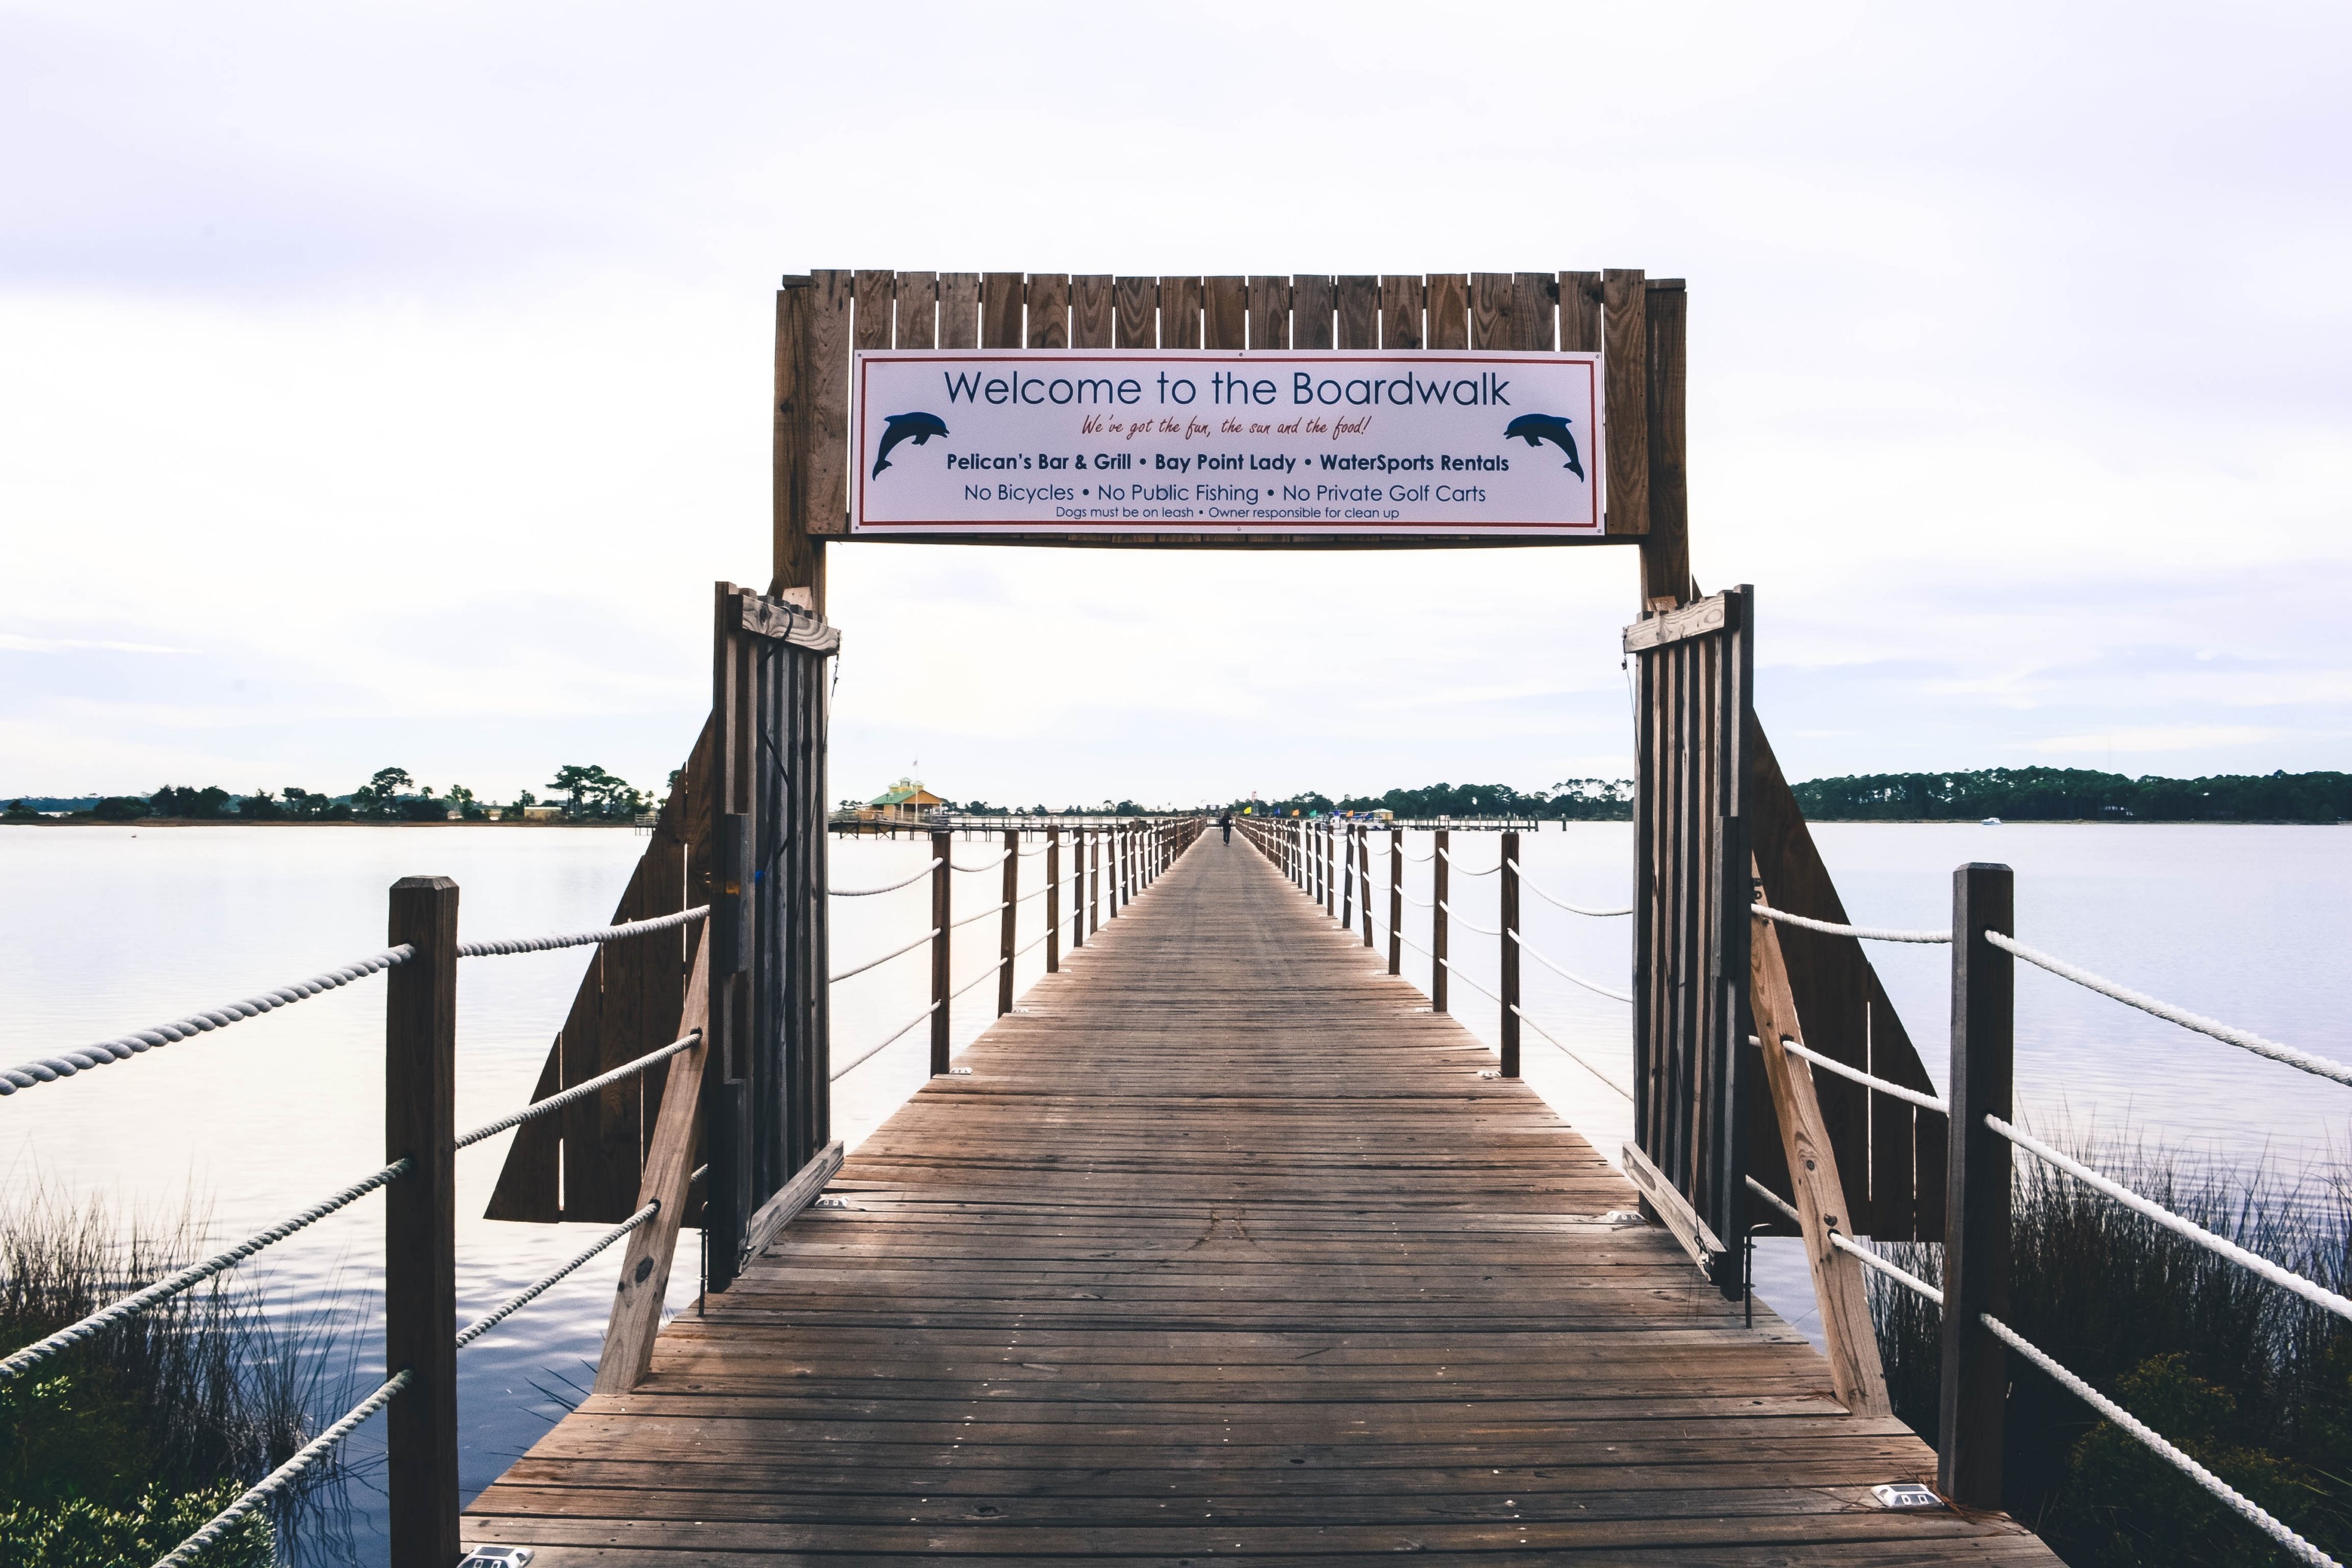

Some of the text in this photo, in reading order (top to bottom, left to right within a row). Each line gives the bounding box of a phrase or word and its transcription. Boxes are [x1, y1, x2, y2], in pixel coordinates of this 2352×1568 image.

[944, 371, 1511, 406] Welcome to the Boardwalk
[1082, 414, 1372, 440] We've got the fun, the sun and the food!
[947, 453, 1510, 475] Pelican's Bar & Grill Bay Point Lady WaterSports Rentals
[965, 484, 1486, 505] No Bicycles No Public Fishing No Private Golf Carts
[1056, 507, 1400, 521] Dogs must be on leash Owner responsible for clean up
